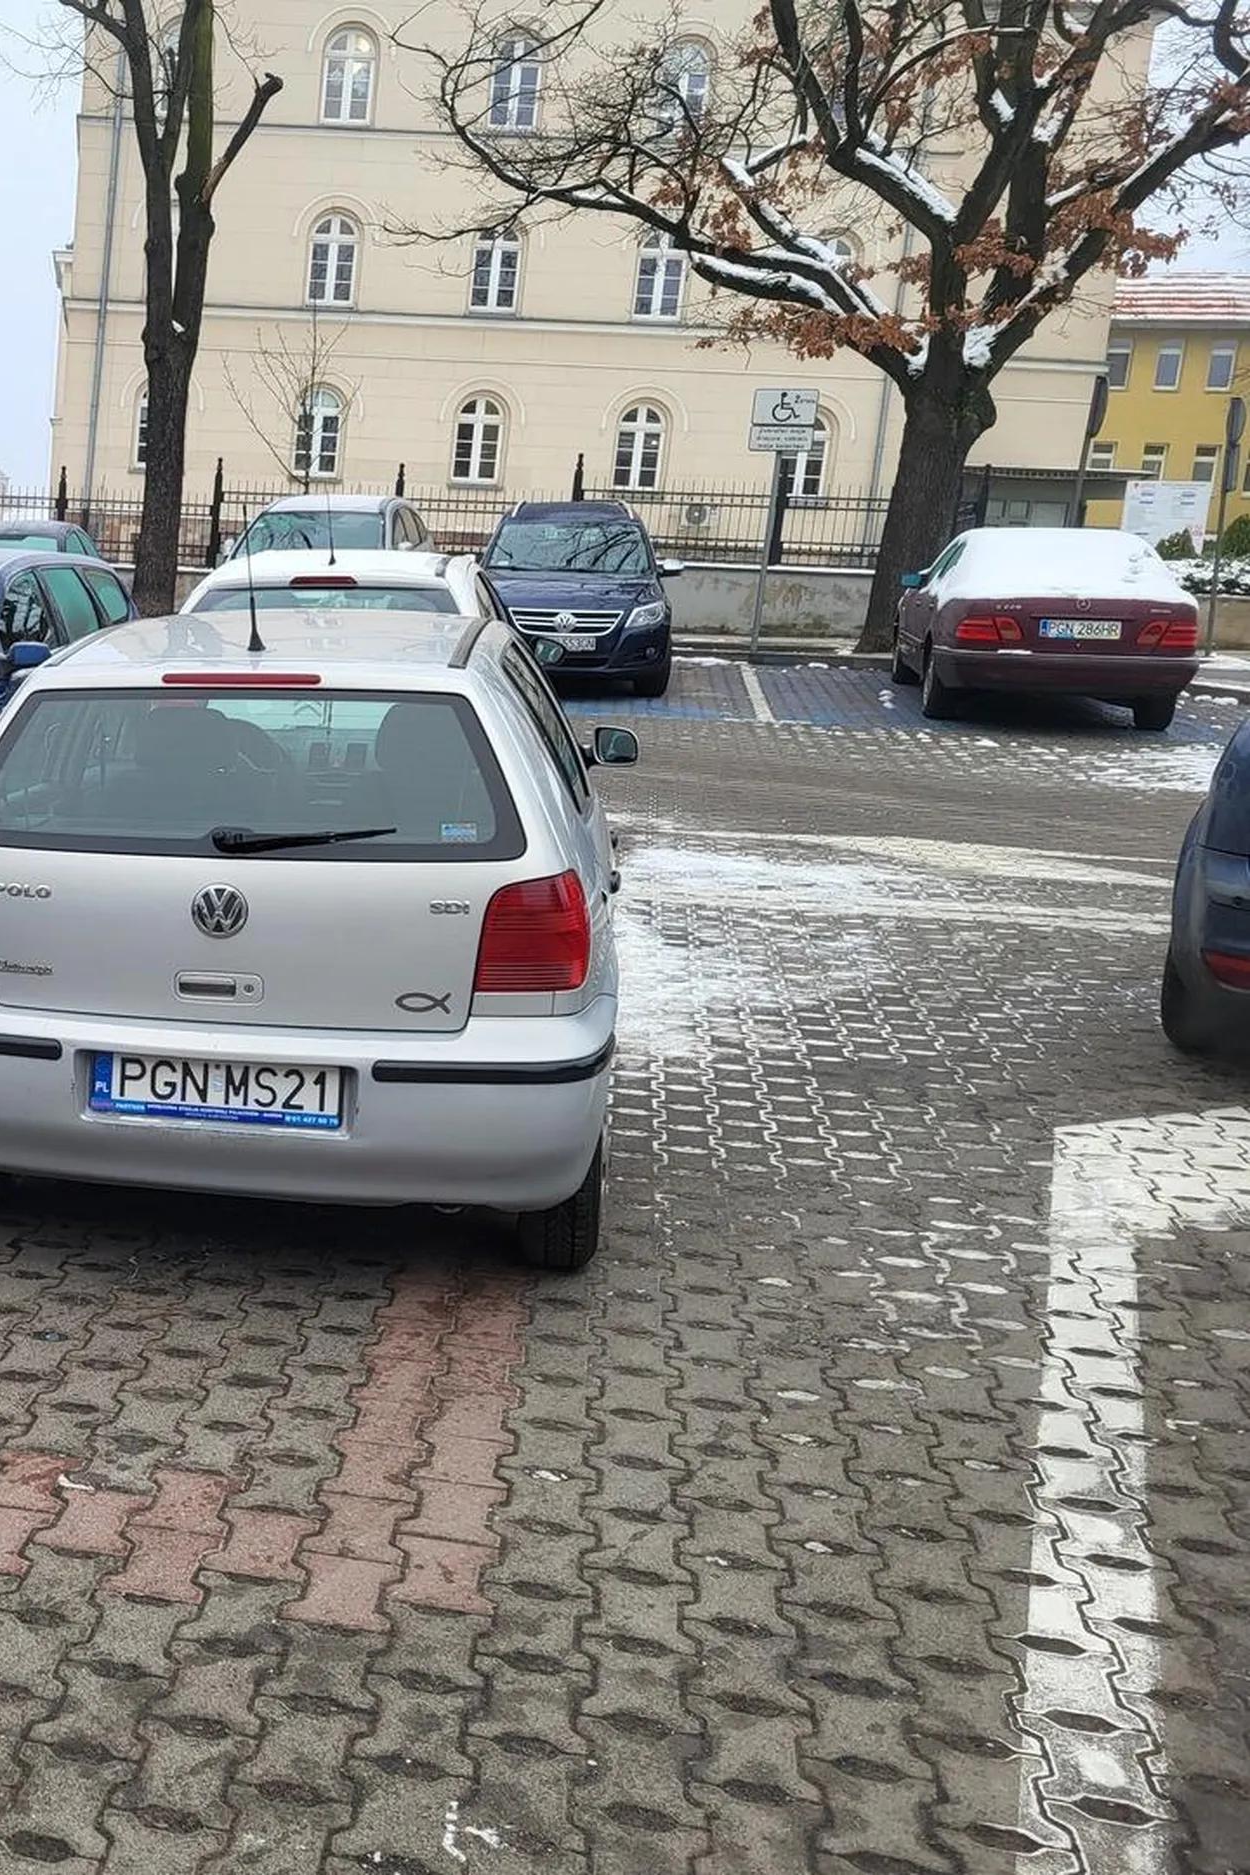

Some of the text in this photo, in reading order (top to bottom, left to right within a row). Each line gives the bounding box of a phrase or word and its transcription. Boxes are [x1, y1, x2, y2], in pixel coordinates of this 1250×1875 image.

[1049, 621, 1120, 636] PGN 286HR
[429, 900, 470, 915] SDI
[95, 1081, 110, 1093] PL
[119, 1057, 327, 1112] PGN MS21
